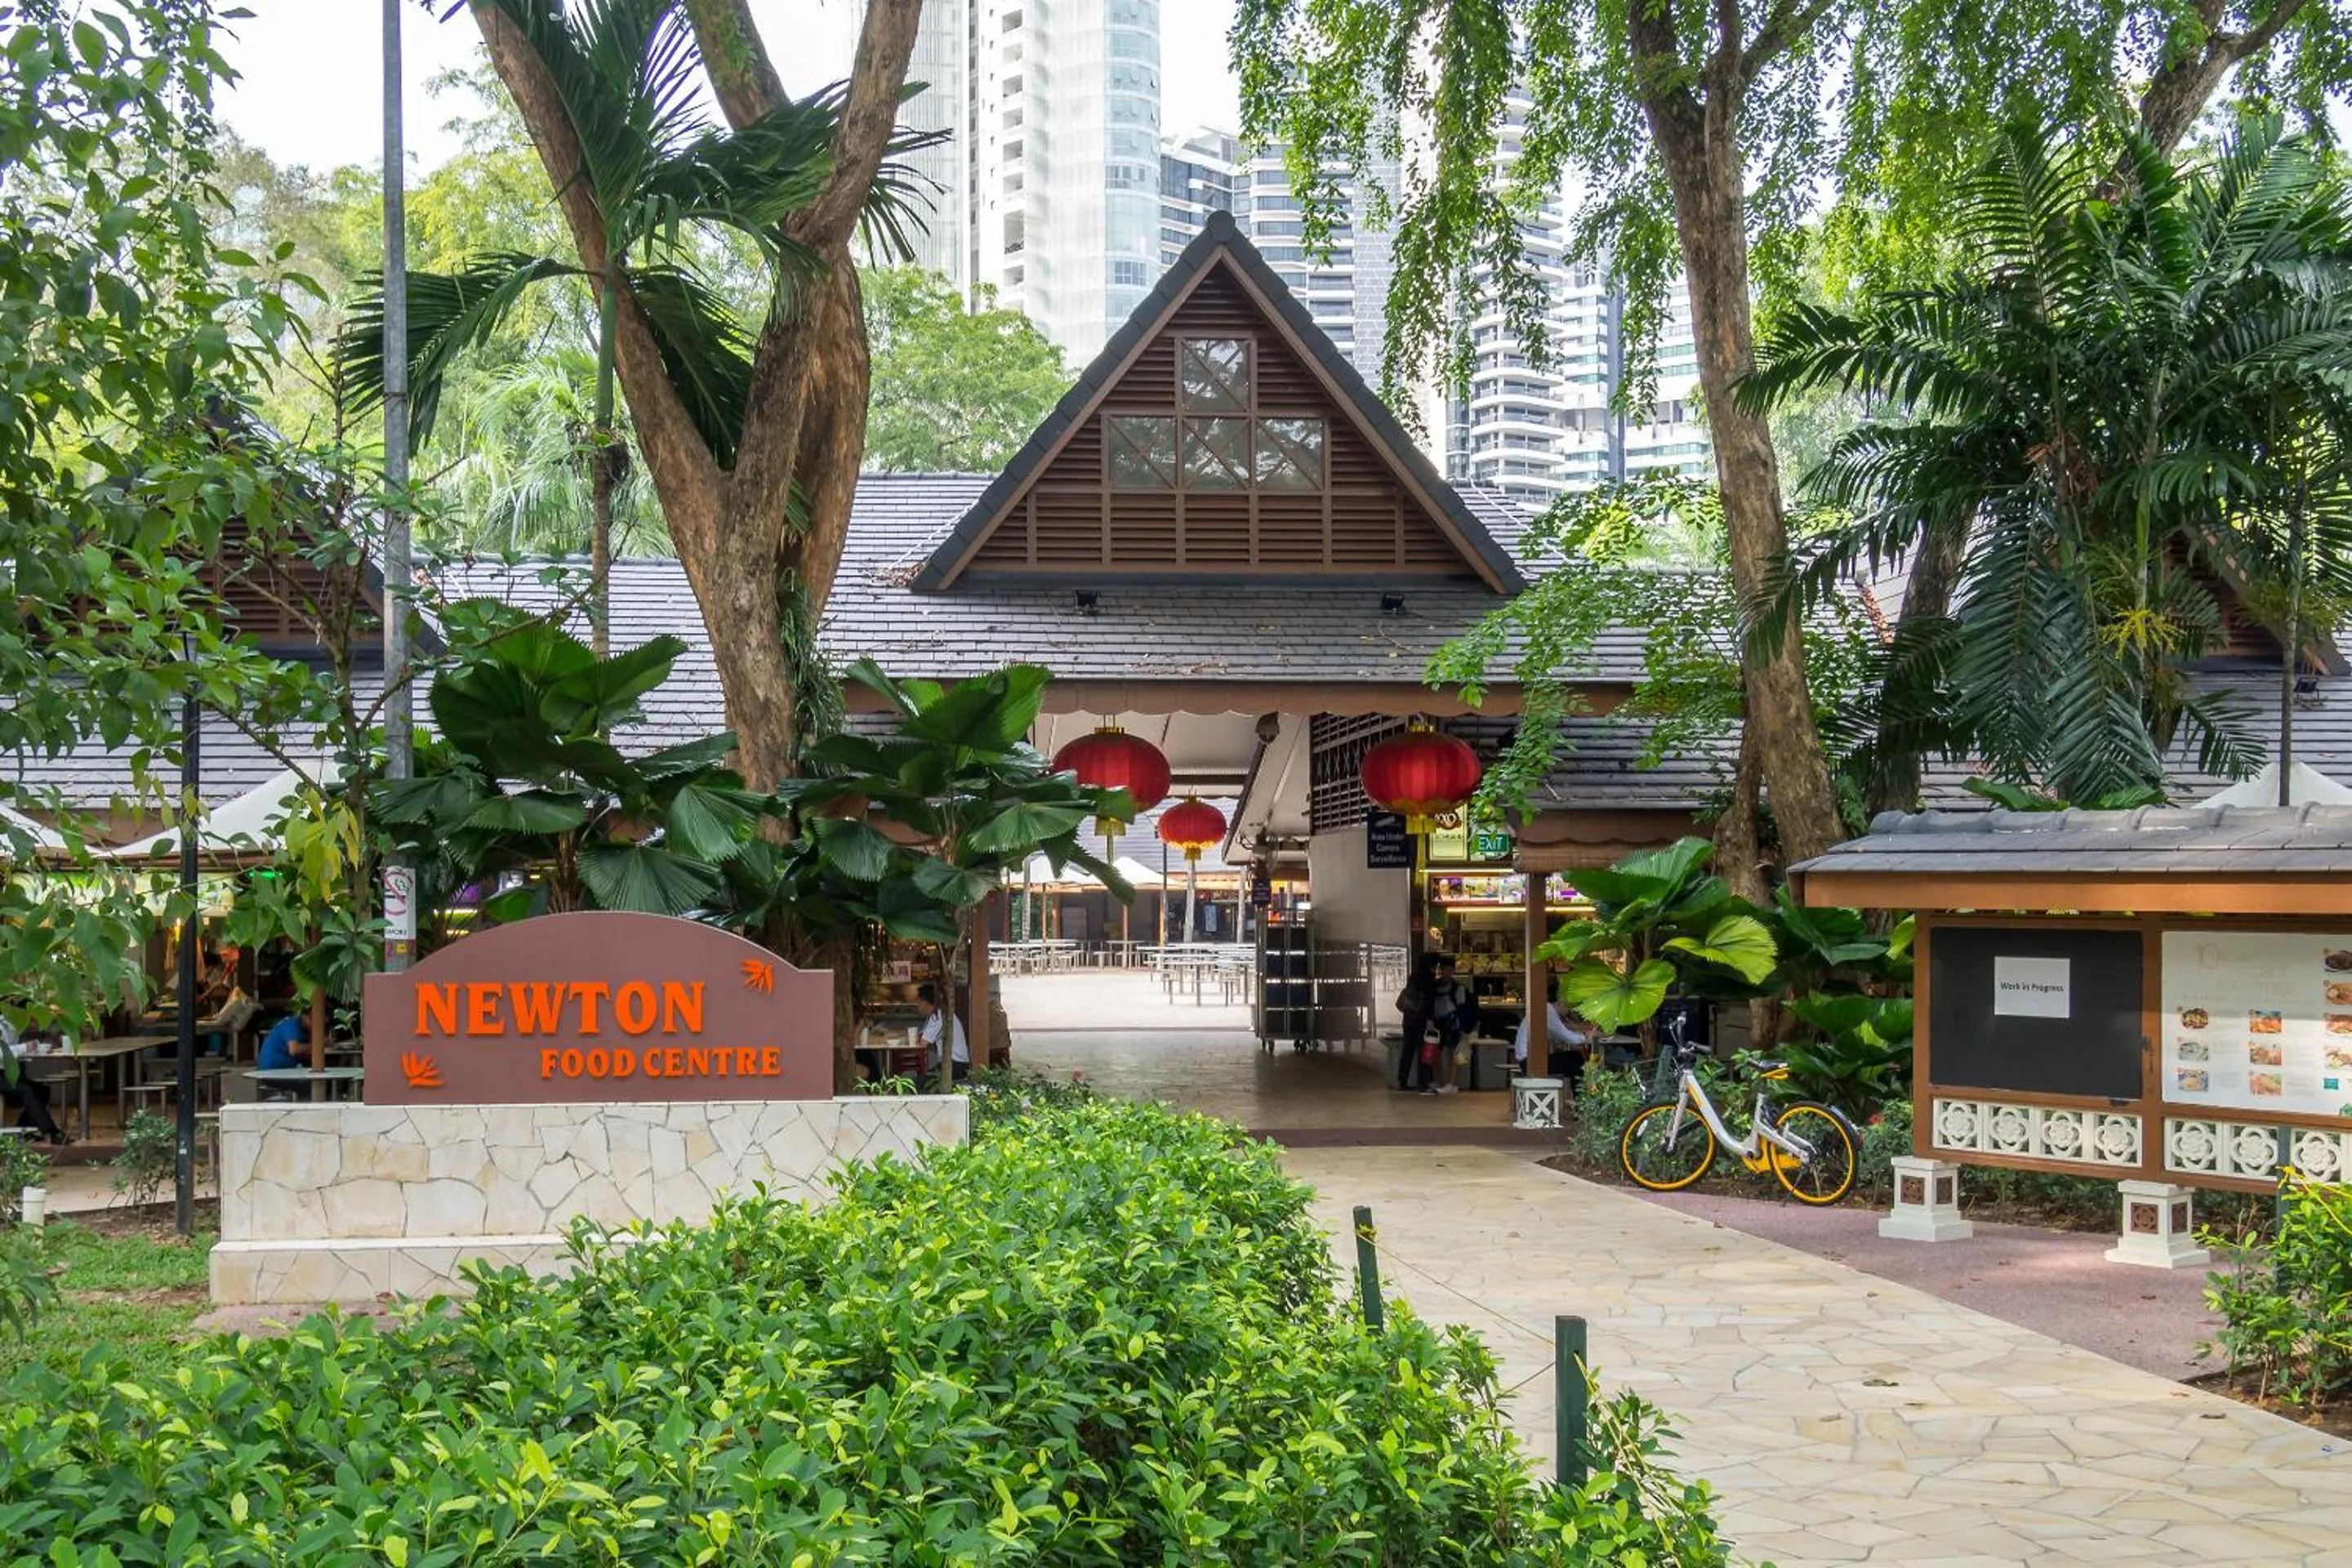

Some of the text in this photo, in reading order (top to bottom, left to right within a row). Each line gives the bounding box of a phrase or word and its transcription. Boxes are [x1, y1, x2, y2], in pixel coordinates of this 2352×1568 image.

[1478, 836, 1503, 850] EXIT
[2000, 982, 2065, 993] Work in Progress
[415, 980, 704, 1036] NEWTON
[541, 1046, 782, 1079] FOOD CENTRE
